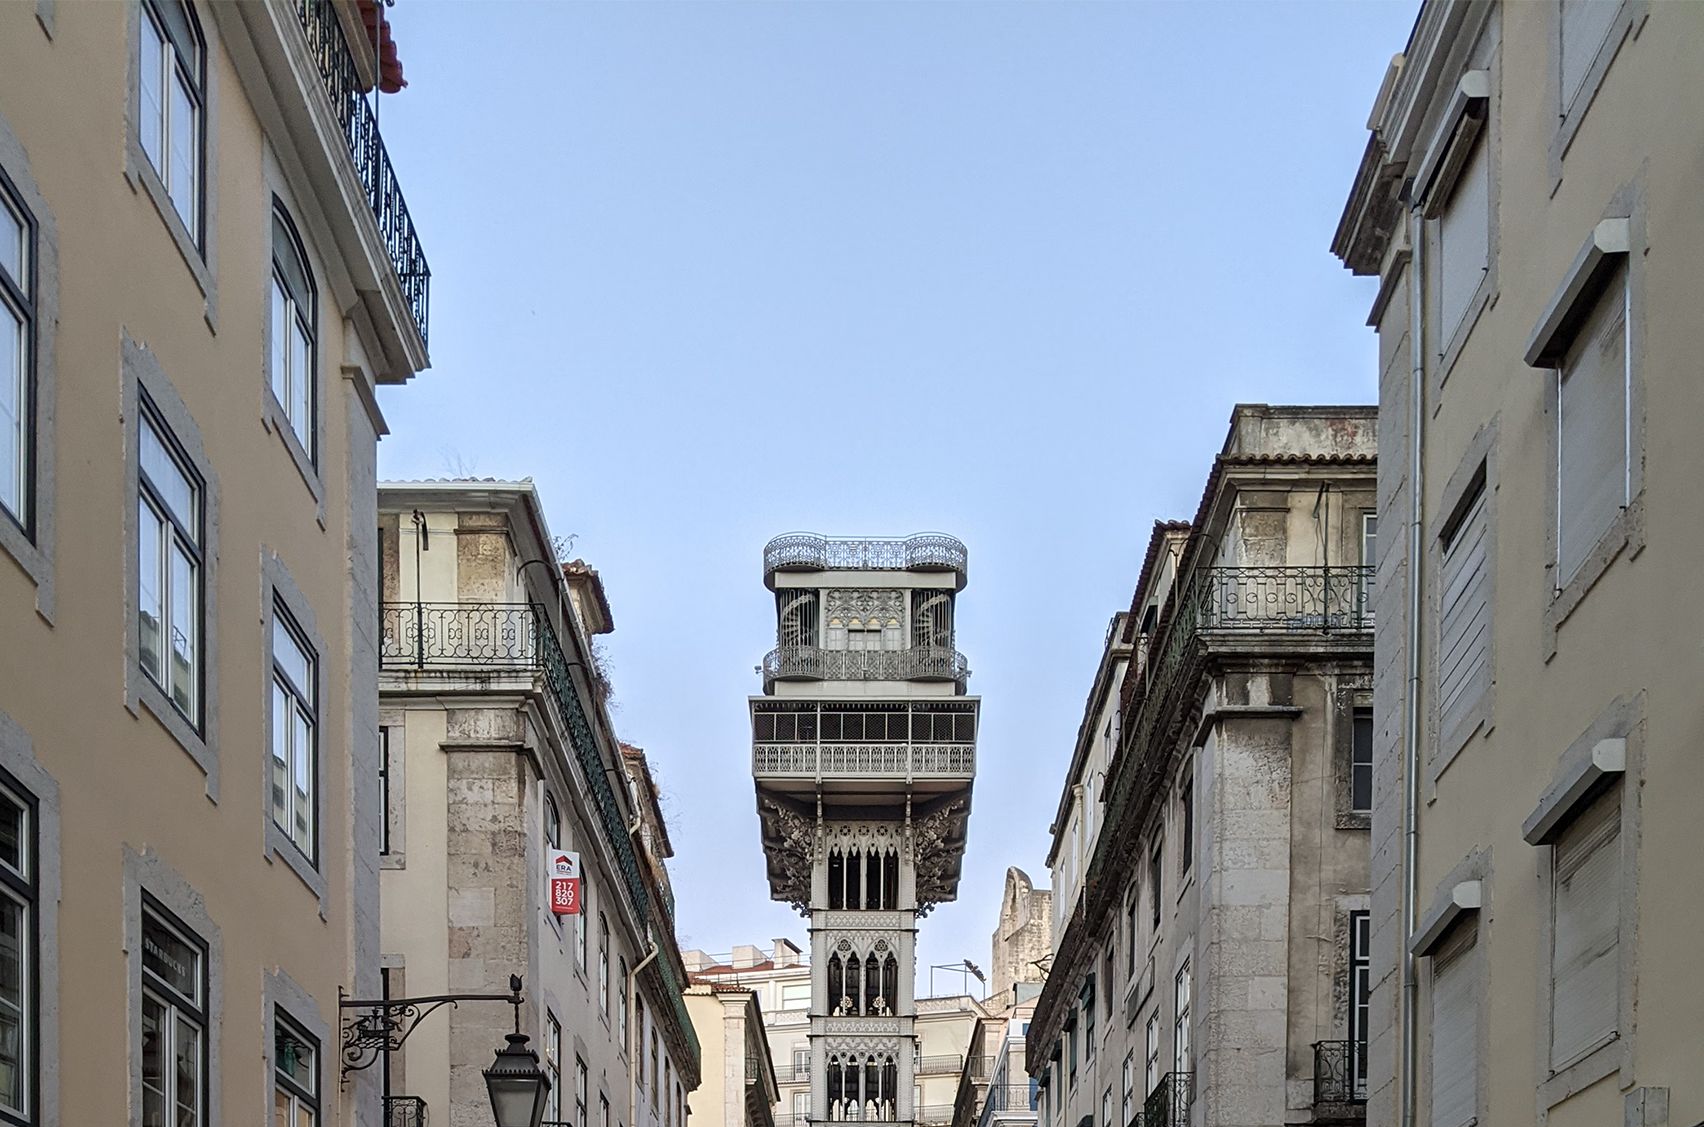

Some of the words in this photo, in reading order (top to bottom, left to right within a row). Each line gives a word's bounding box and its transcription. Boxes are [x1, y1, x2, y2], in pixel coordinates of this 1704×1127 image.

[555, 881, 573, 890] 217
[555, 890, 574, 898] 820
[555, 897, 573, 905] 307
[144, 937, 186, 977] STARBUCKS
